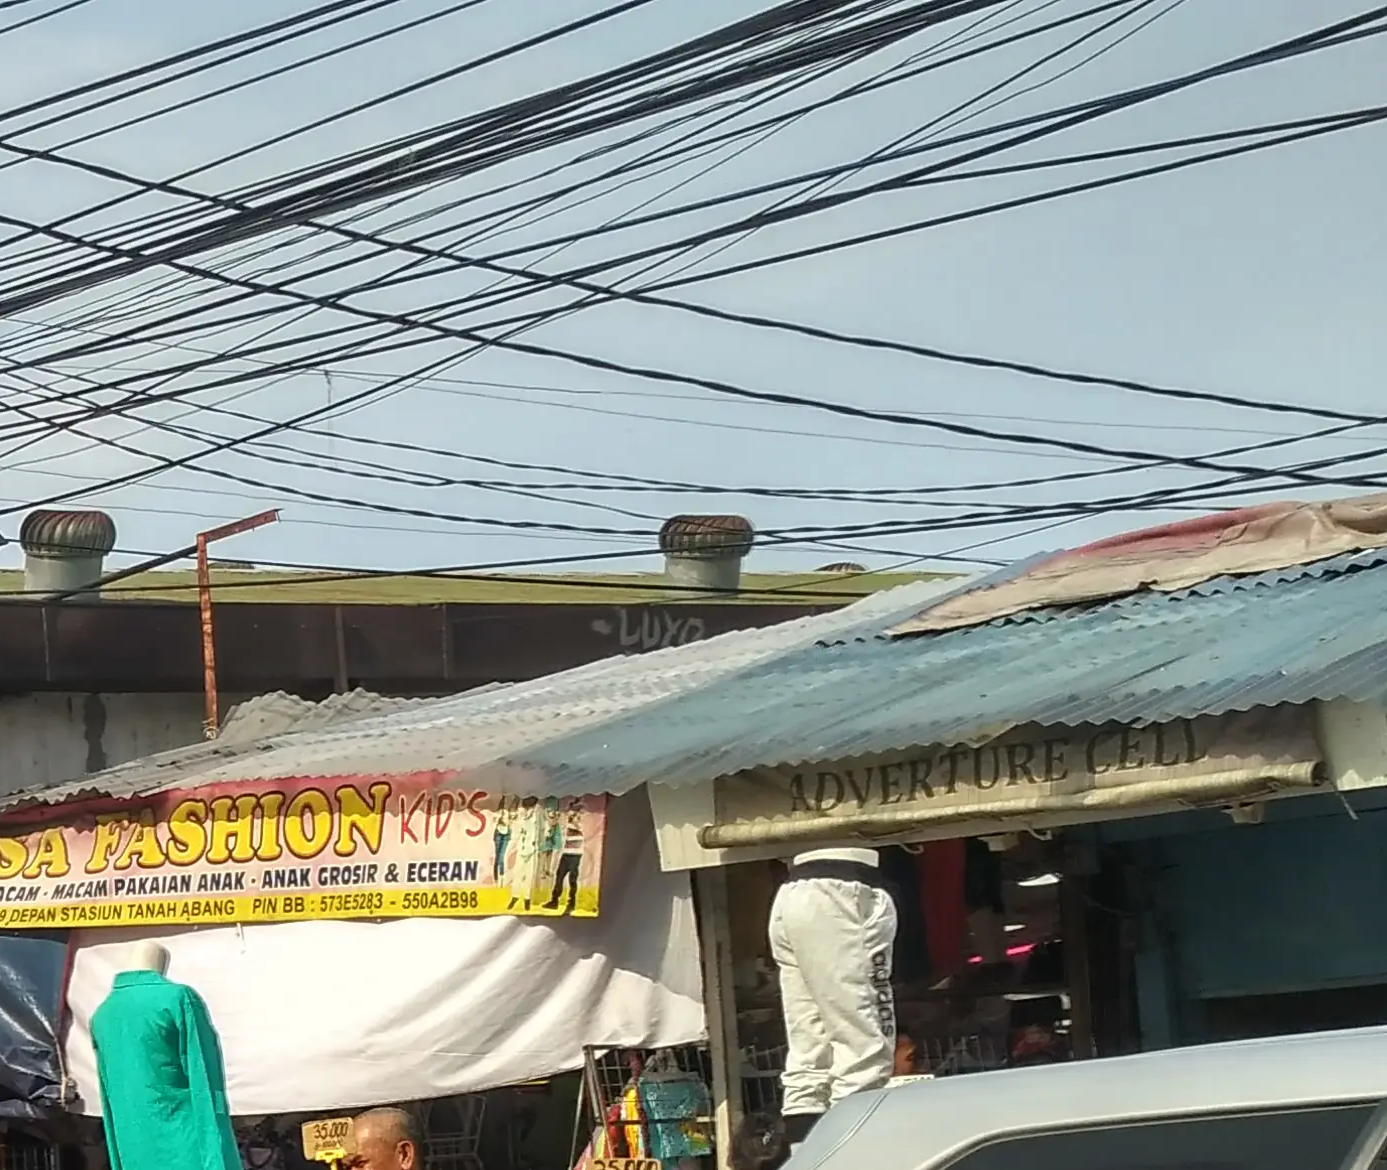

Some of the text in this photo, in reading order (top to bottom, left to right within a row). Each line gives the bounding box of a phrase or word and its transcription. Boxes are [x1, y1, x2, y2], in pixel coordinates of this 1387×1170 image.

[789, 719, 1208, 813] ADVERTURE CELL
[84, 781, 393, 874] FASHION
[399, 790, 488, 845] KID'S
[51, 880, 108, 900] MACAM
[114, 874, 193, 897] PAKAIAN
[196, 872, 246, 892] ANAK
[262, 867, 311, 888] ANAK
[318, 863, 378, 886] GROSIR
[385, 862, 399, 883] &
[407, 860, 479, 883] ECERAN
[61, 905, 123, 922] STASIUN
[127, 900, 177, 920] TANAH
[178, 899, 236, 918] ABANG
[252, 897, 279, 914] PIN
[282, 896, 305, 912] BB
[319, 893, 384, 911] 573E5283
[402, 891, 479, 910] 550A2B98
